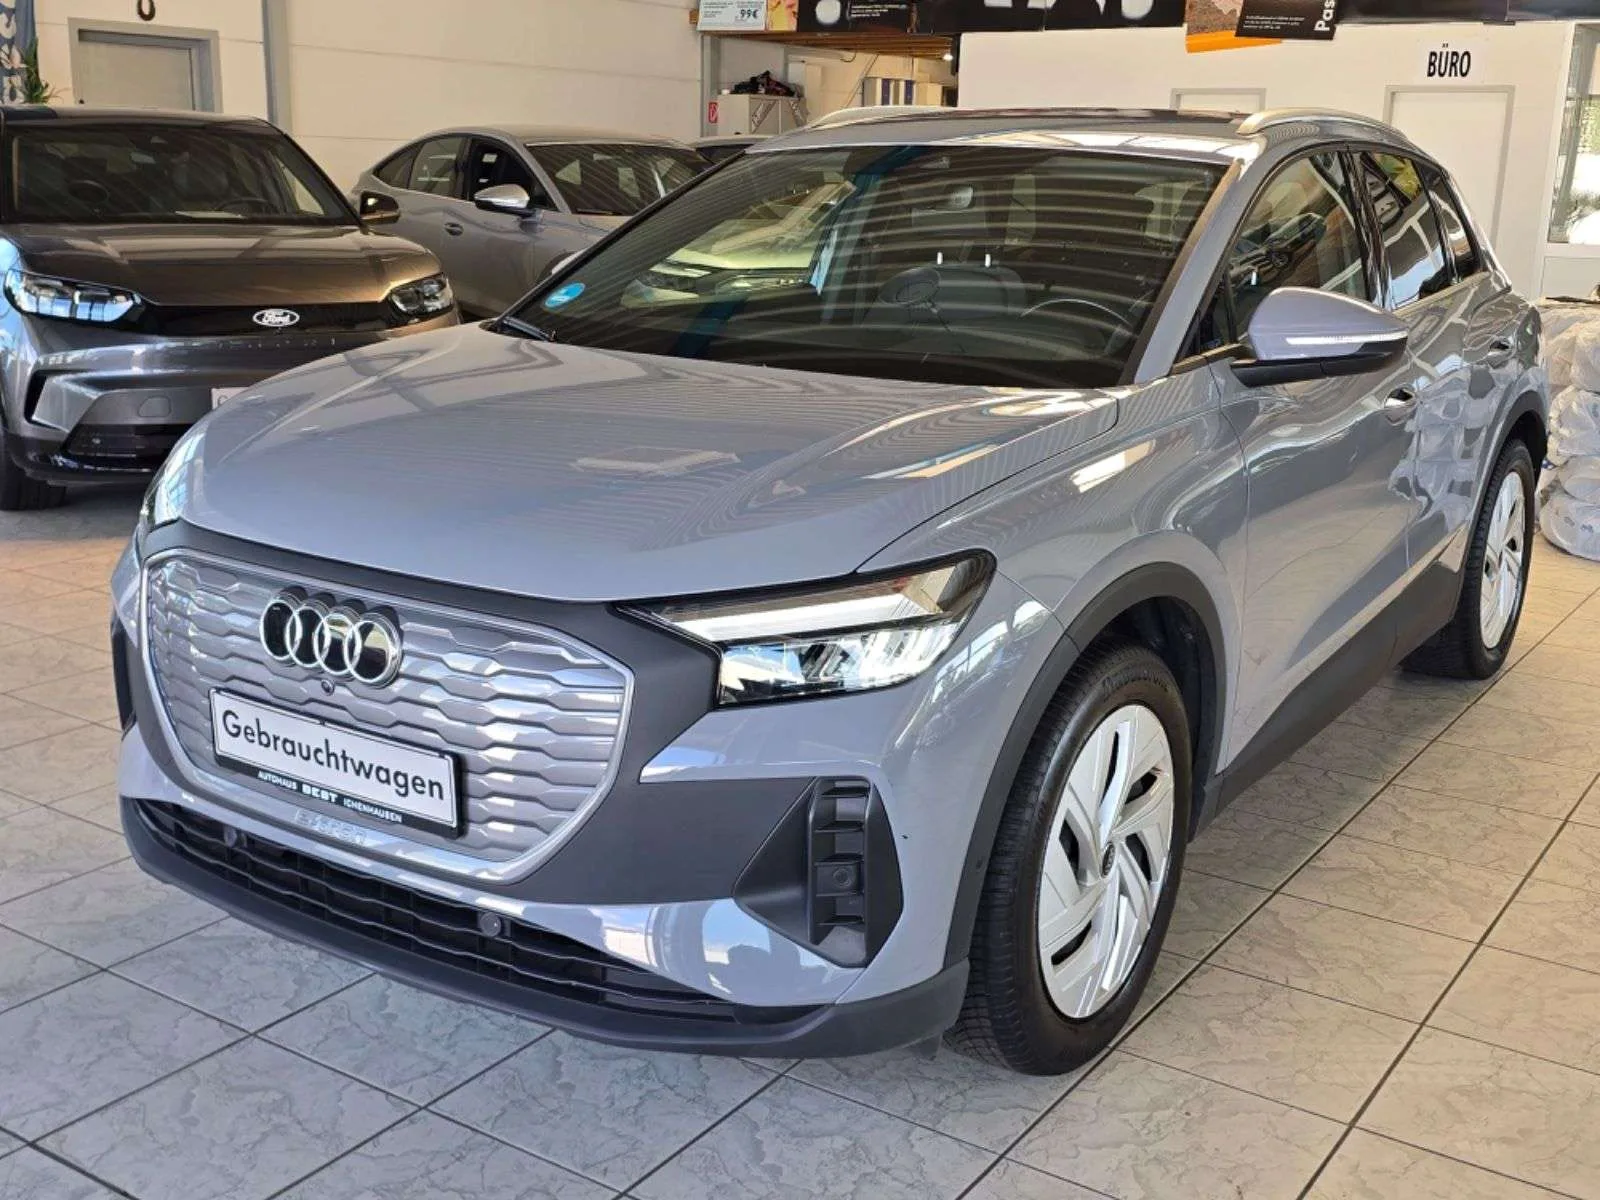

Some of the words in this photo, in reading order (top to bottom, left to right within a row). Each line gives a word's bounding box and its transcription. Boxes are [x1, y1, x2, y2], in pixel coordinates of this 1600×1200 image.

[1427, 43, 1472, 78] BÜRO
[258, 310, 293, 326] Ford
[222, 710, 445, 800] Gebrauchtwagen
[257, 770, 298, 790] AUTOHAUS
[343, 797, 403, 823] ICHENHAUSEN
